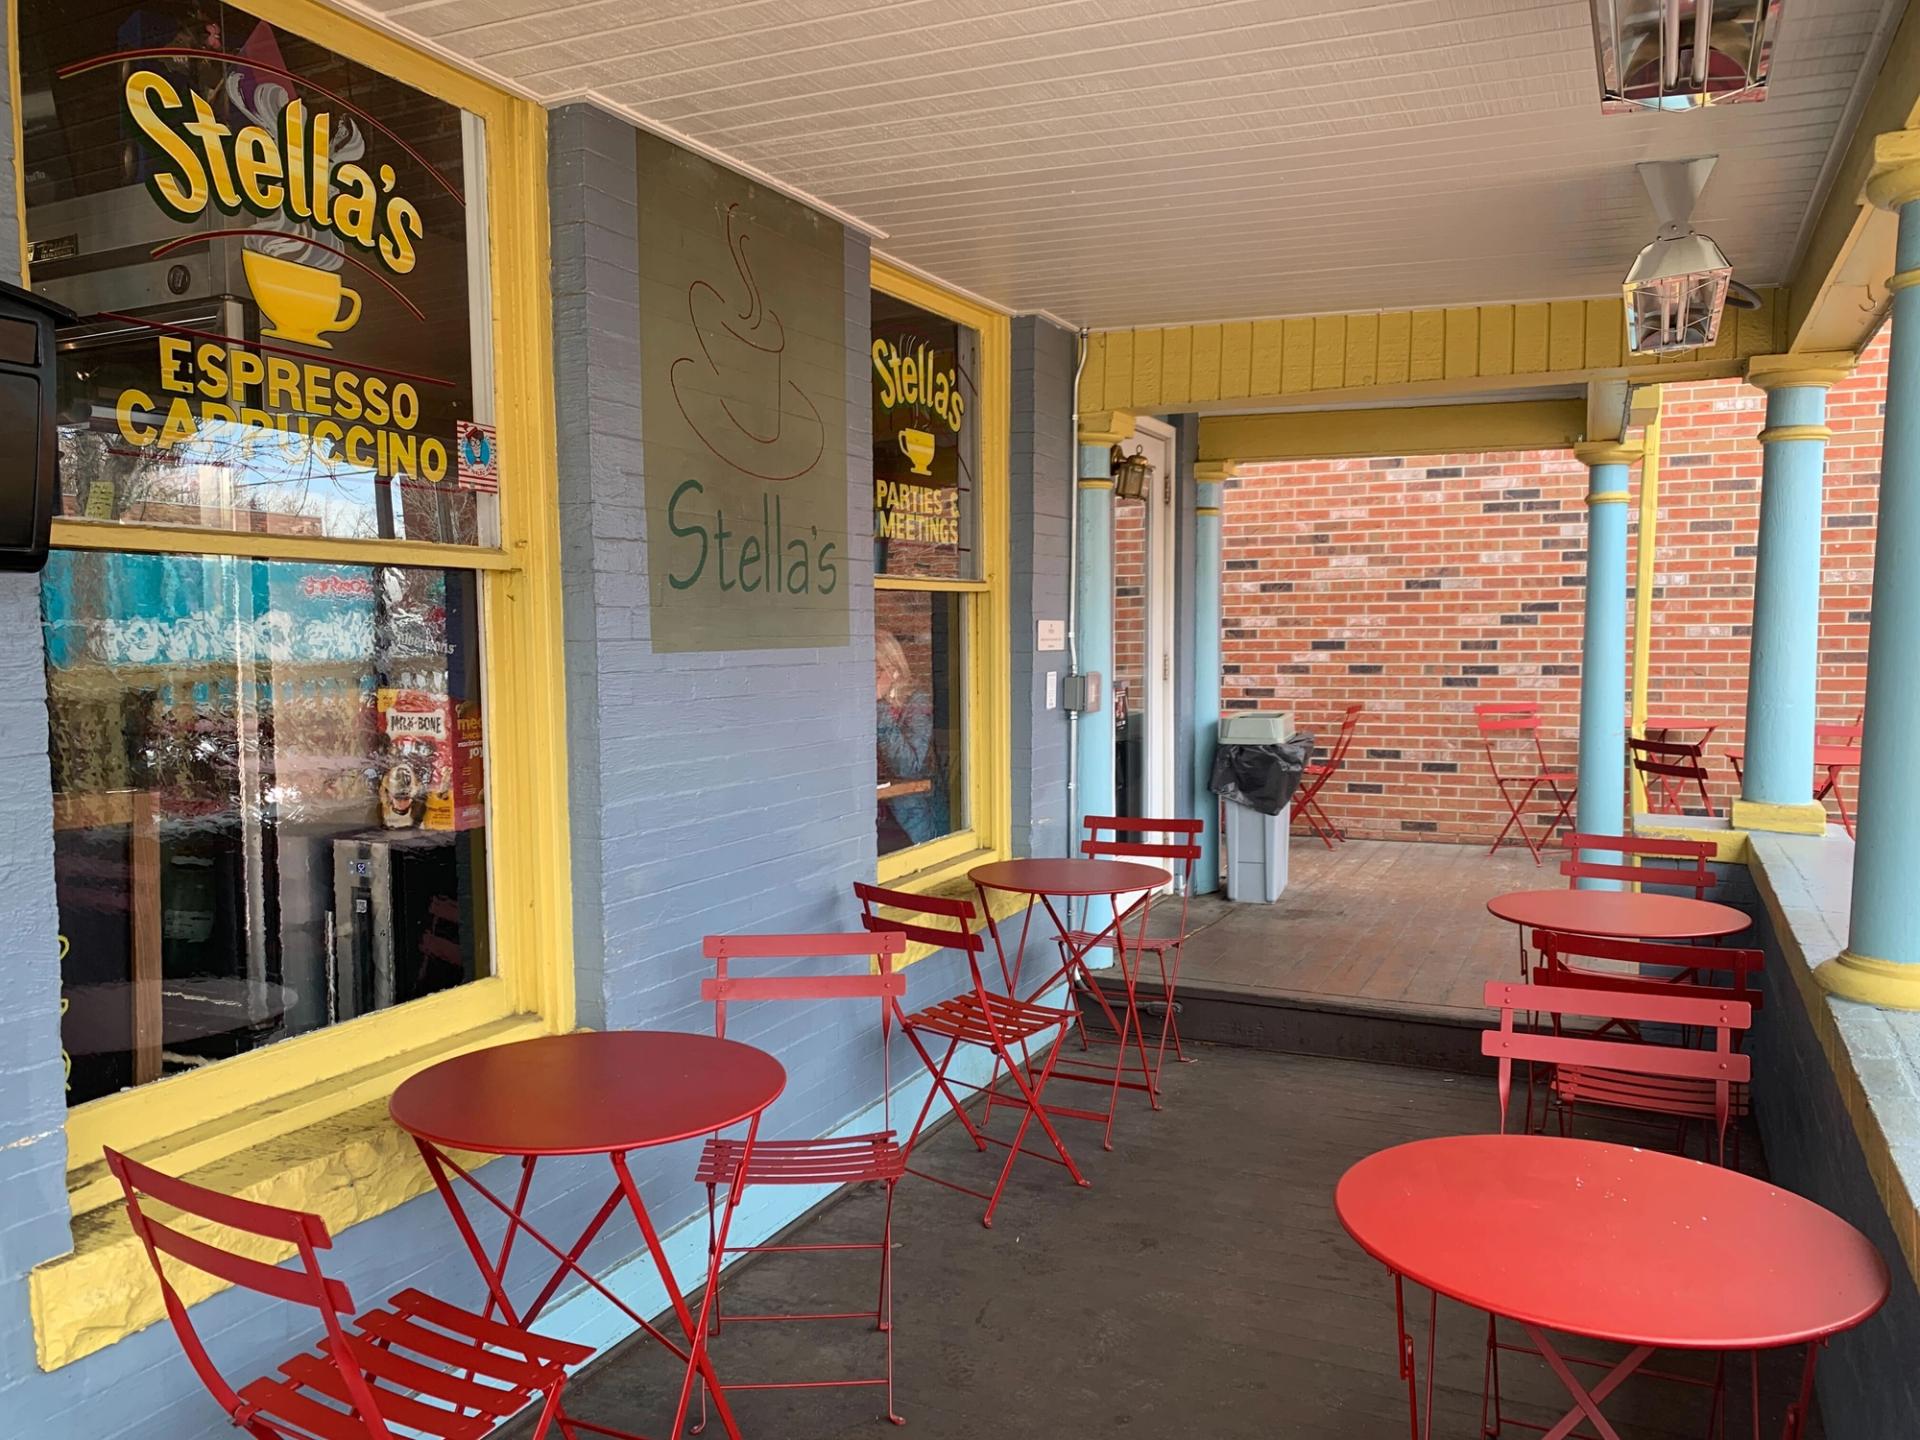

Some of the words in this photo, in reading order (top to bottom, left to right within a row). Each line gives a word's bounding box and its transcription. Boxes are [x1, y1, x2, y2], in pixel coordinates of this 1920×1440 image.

[124, 70, 424, 274] Stella's
[158, 335, 420, 431] ESPRESSO
[872, 338, 964, 432] Stella's
[115, 388, 448, 484] CAPPUCCINO
[668, 479, 837, 595] Stella's
[876, 479, 944, 515] PARTIES
[949, 490, 960, 518] &
[879, 510, 960, 544] MEETINGS
